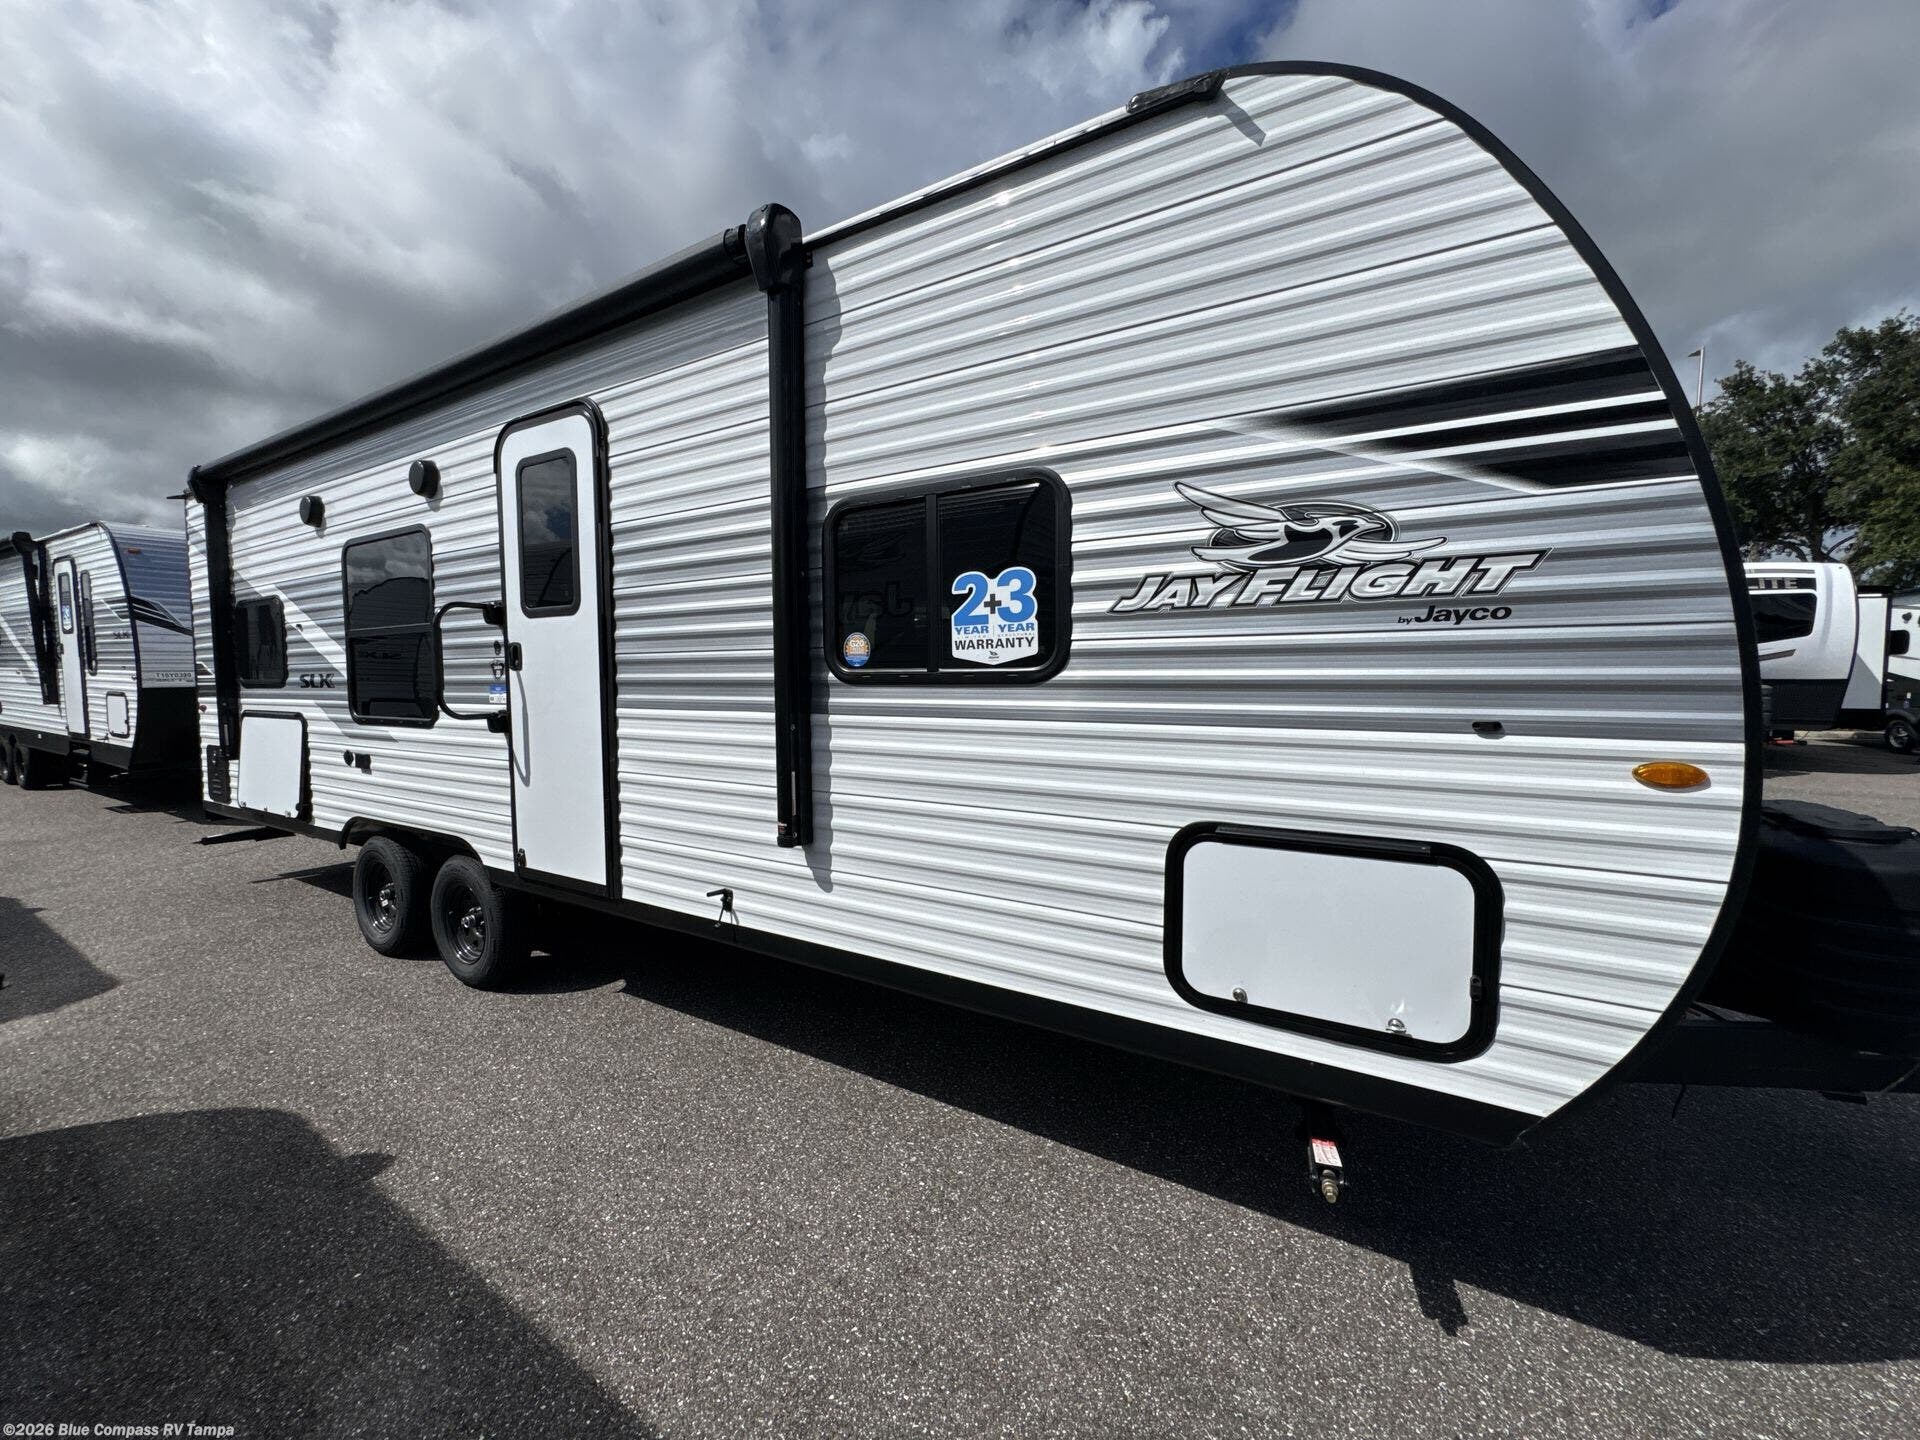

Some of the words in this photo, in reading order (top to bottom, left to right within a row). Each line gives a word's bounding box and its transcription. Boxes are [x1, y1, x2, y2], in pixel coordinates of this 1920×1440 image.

[1398, 616, 1413, 625] by
[1414, 605, 1512, 625] Jayco
[955, 625, 989, 635] YEAR
[998, 622, 1035, 633] YEAR
[955, 636, 1035, 650] WARRANTY
